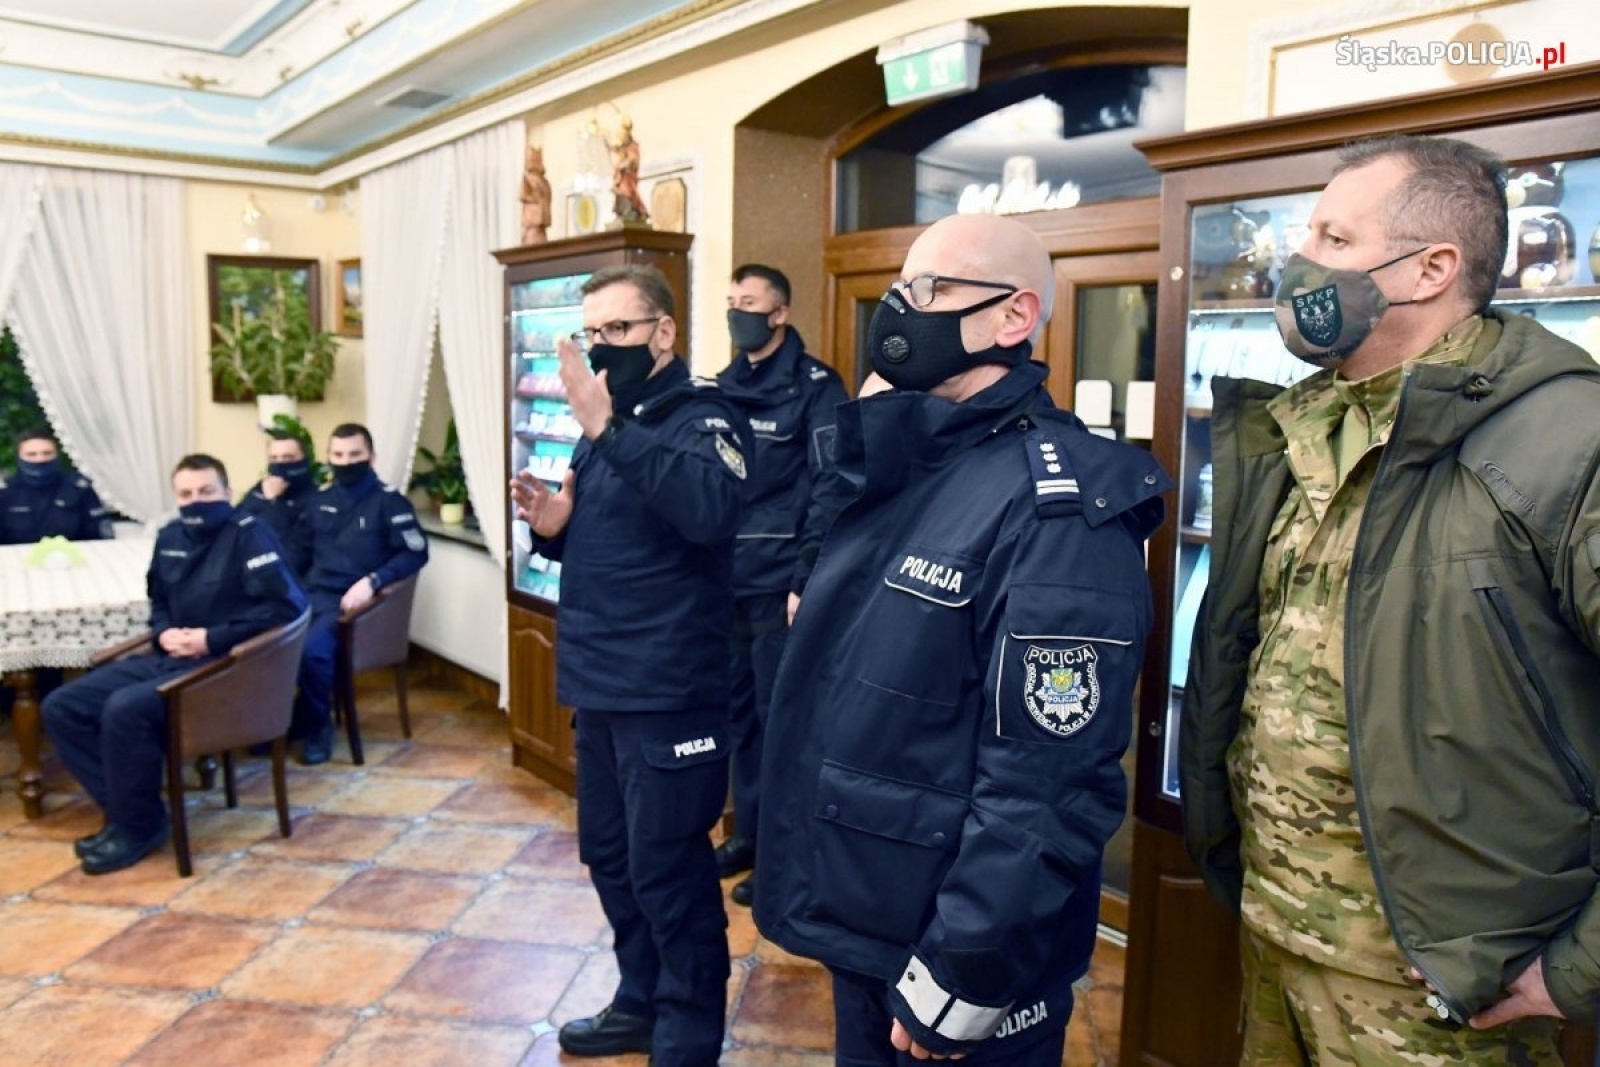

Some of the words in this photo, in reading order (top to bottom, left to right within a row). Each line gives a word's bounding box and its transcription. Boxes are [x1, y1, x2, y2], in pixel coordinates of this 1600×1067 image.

[1296, 288, 1334, 308] SPKP
[899, 555, 963, 594] POLICJA
[1028, 648, 1094, 665] POLICJA
[1049, 695, 1077, 703] POLICJA
[673, 736, 717, 758] POLICJA
[995, 1000, 1048, 1039] OLICJA
